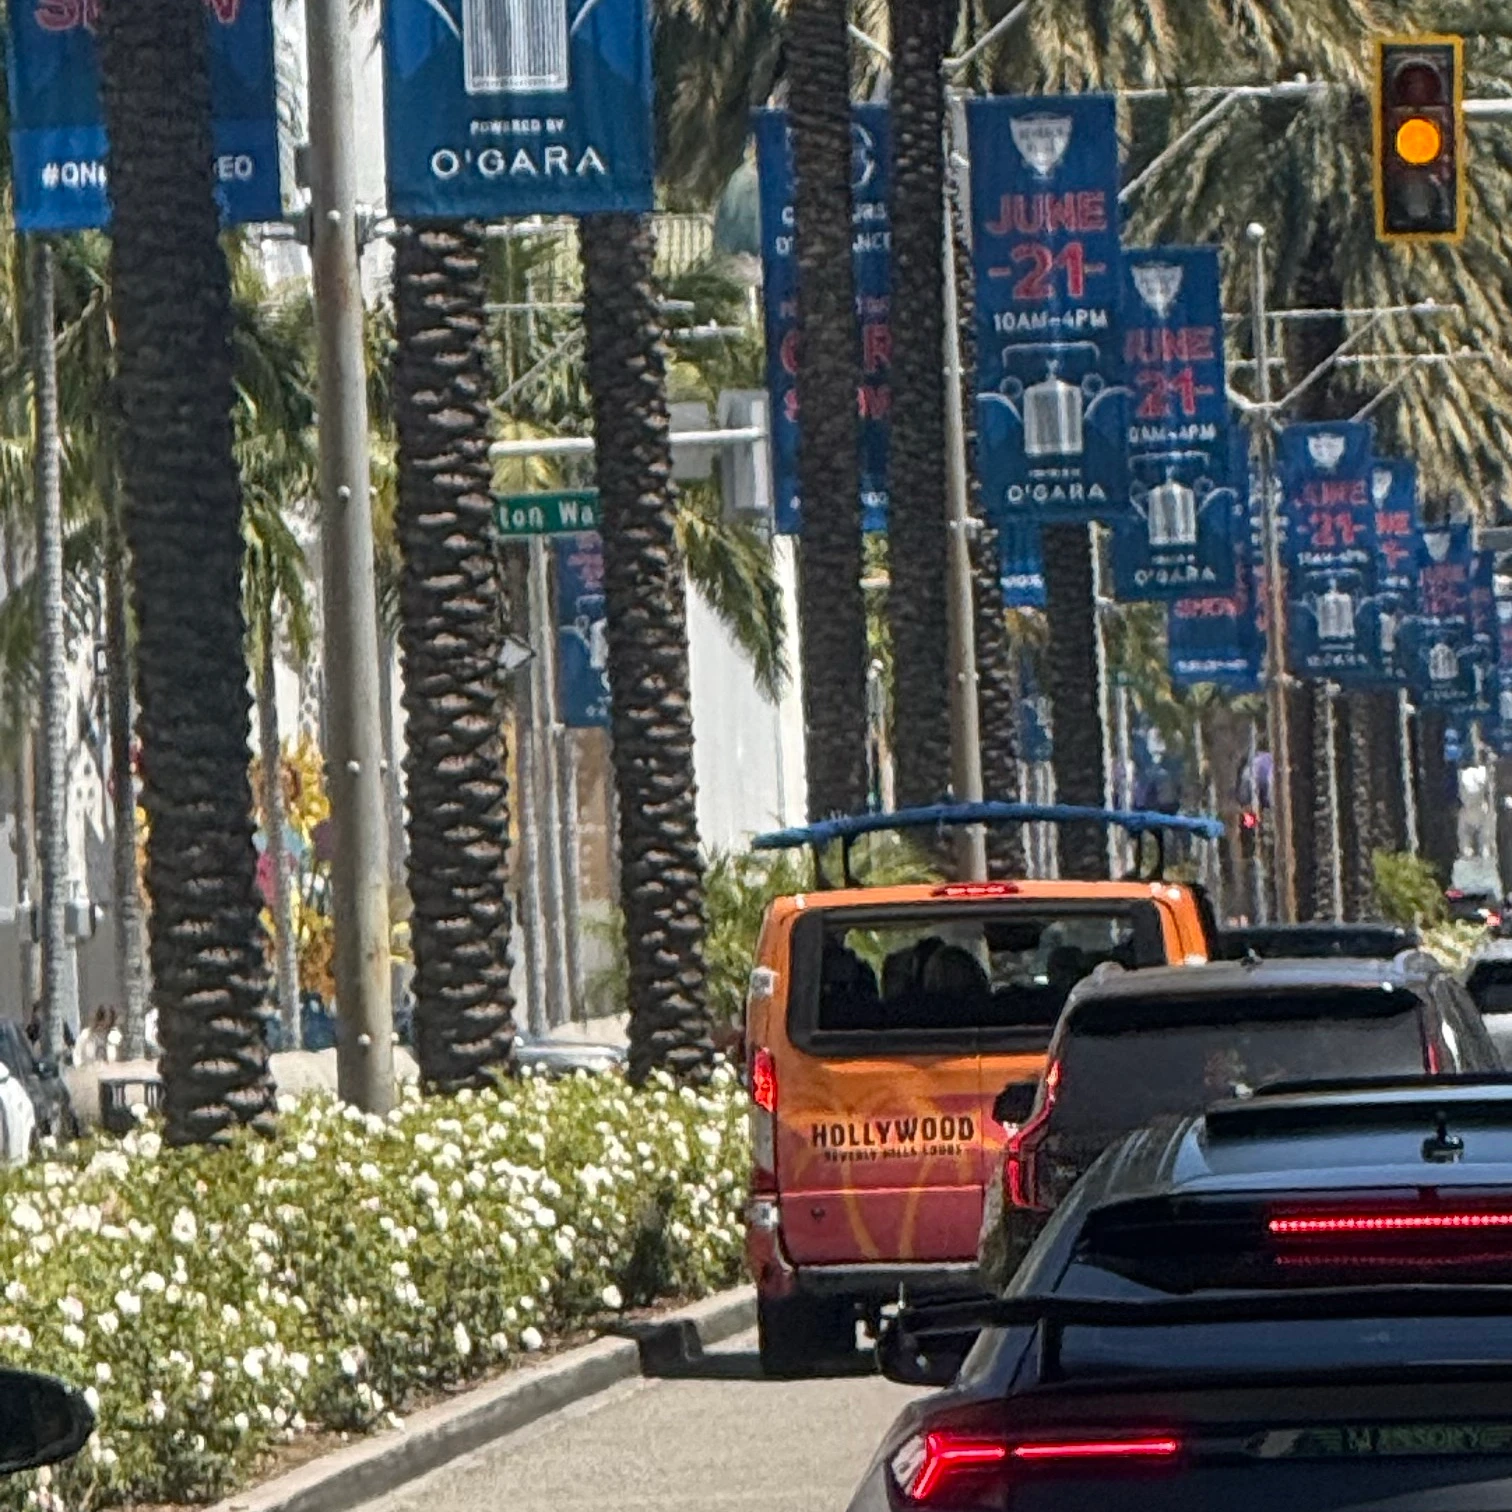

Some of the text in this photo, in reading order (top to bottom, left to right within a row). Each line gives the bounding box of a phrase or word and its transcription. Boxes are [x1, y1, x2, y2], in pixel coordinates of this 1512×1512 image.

[430, 145, 606, 180] O'GARA
[985, 191, 1107, 235] JUNE
[558, 500, 595, 527] Wa
[811, 1115, 975, 1148] HOLLYWOOD
